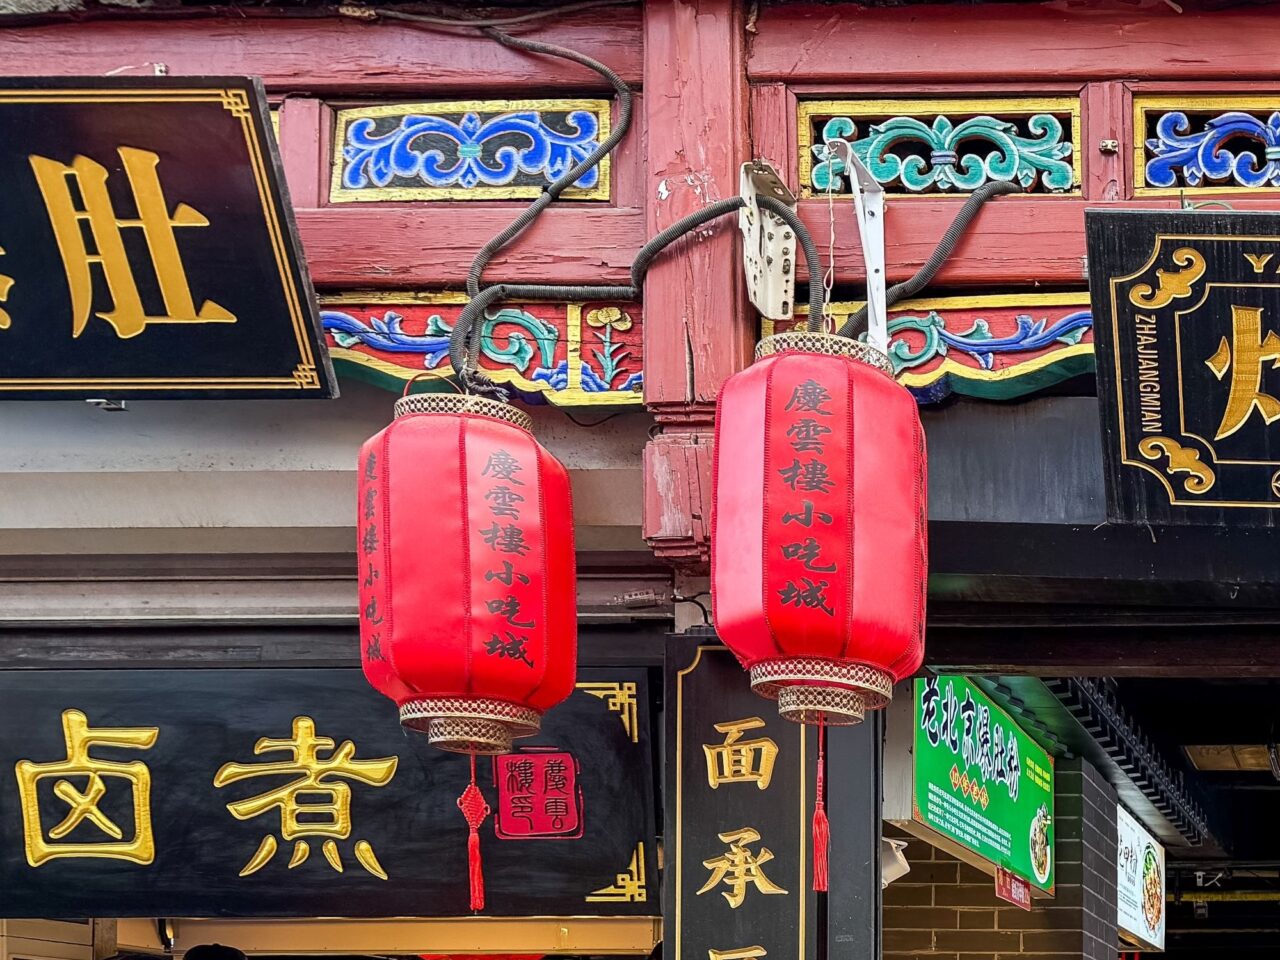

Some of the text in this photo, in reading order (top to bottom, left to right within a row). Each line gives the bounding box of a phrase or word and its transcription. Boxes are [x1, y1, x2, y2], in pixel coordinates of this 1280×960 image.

[0, 147, 237, 339] 肚
[1133, 313, 1163, 434] ZHAJIANGMIAN
[477, 448, 536, 669] 慶雲樓小吃城
[776, 378, 837, 617] 慶雲樓小吃城
[14, 708, 399, 881] 卤煮
